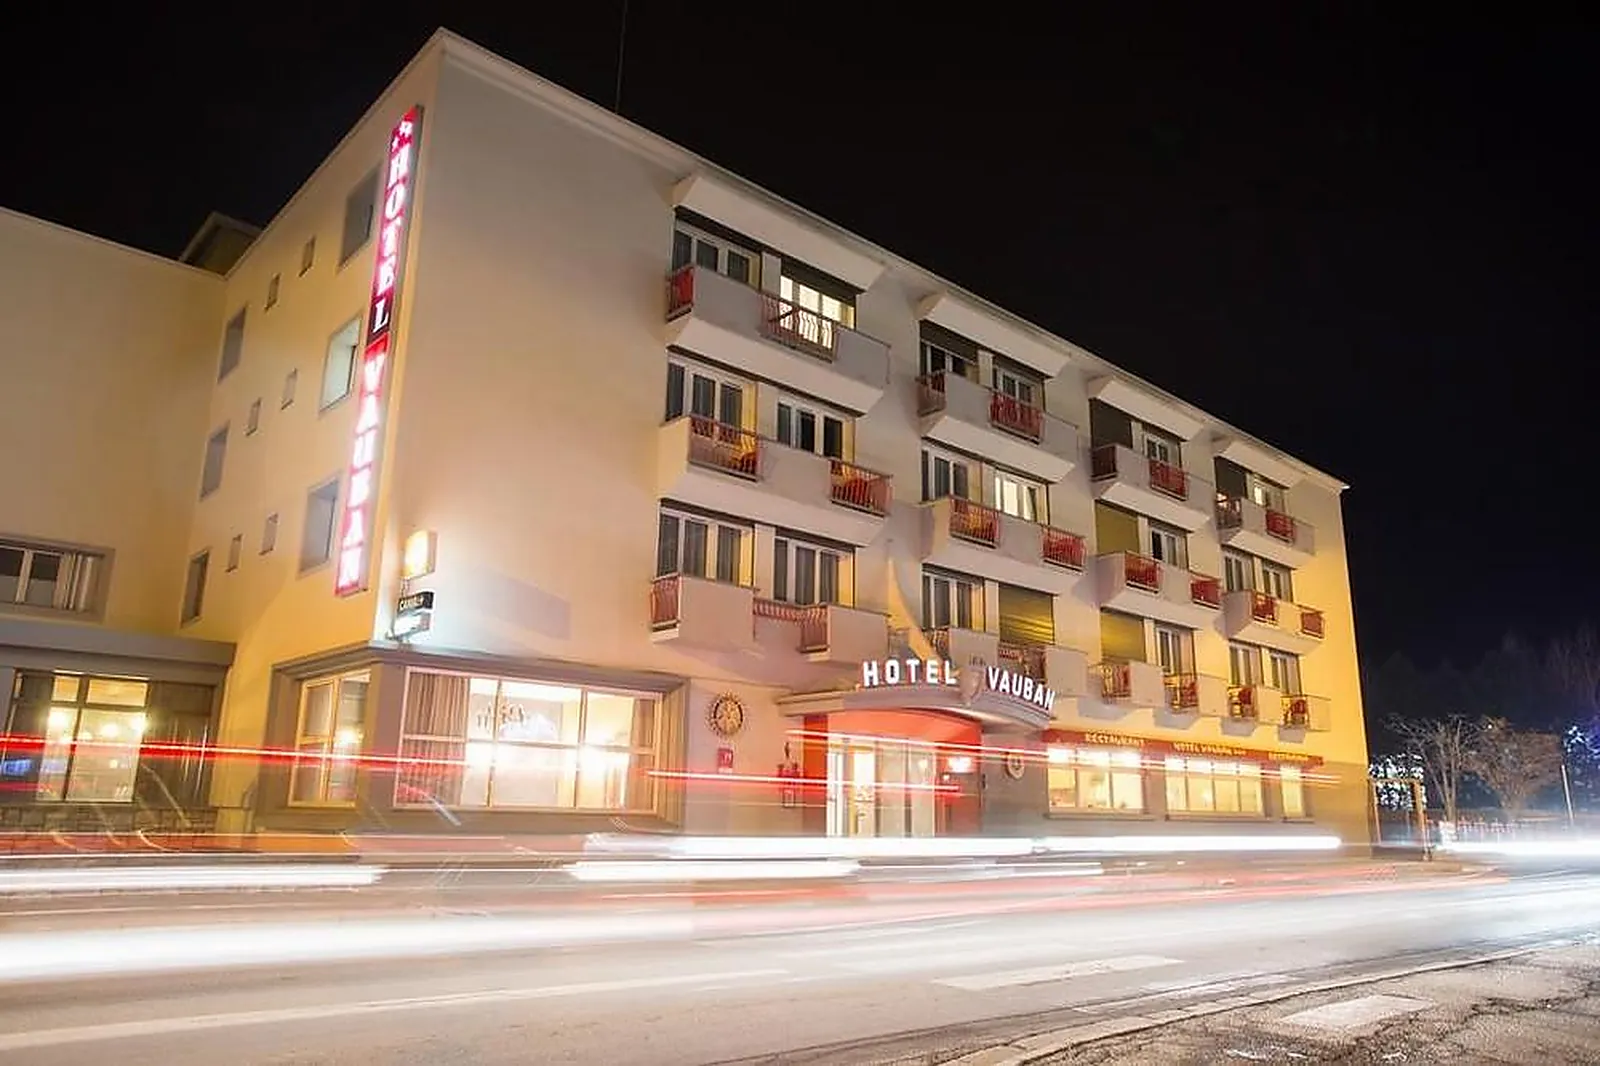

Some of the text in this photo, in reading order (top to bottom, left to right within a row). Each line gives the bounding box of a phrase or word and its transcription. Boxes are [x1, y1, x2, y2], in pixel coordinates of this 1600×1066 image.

[372, 144, 410, 333] HOTEL
[338, 353, 386, 588] VAUBAN
[863, 658, 1056, 712] HOTEL VAUBAN
[1084, 732, 1145, 748] RESTAURANT
